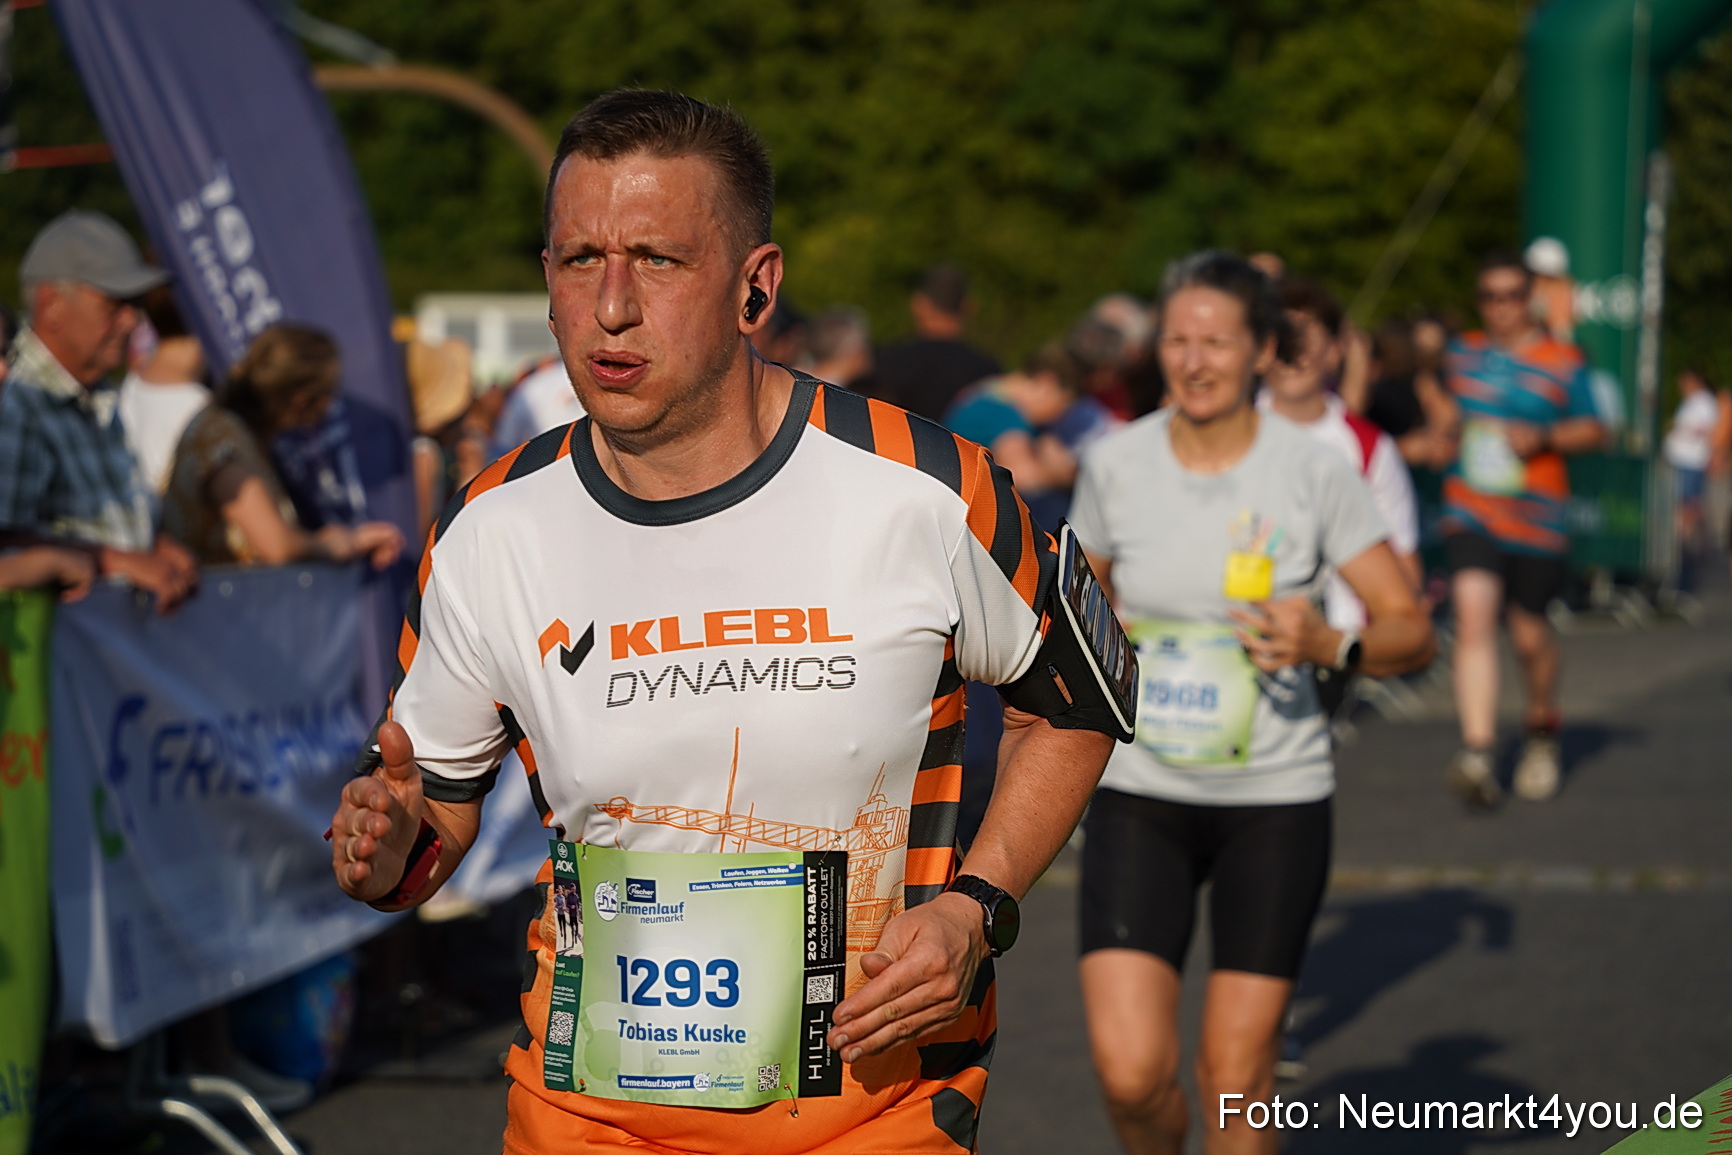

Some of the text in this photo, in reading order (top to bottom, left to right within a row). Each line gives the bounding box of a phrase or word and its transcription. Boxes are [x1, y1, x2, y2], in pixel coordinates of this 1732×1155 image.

[610, 607, 854, 661] KLEBL
[606, 655, 857, 709] DYNAMICS
[555, 859, 575, 873] AOK
[620, 901, 685, 916] Firmenlauf
[640, 914, 684, 924] neumarkt
[807, 866, 817, 961] 20 % RABATT
[820, 866, 829, 959] FACTORY OUTLET
[616, 954, 740, 1008] 1293
[618, 1018, 747, 1044] Tobias Kuske
[808, 1010, 824, 1079] HILTL
[658, 1048, 700, 1056] KLEBL GmbH
[620, 1078, 691, 1089] firmenlauf.bayern
